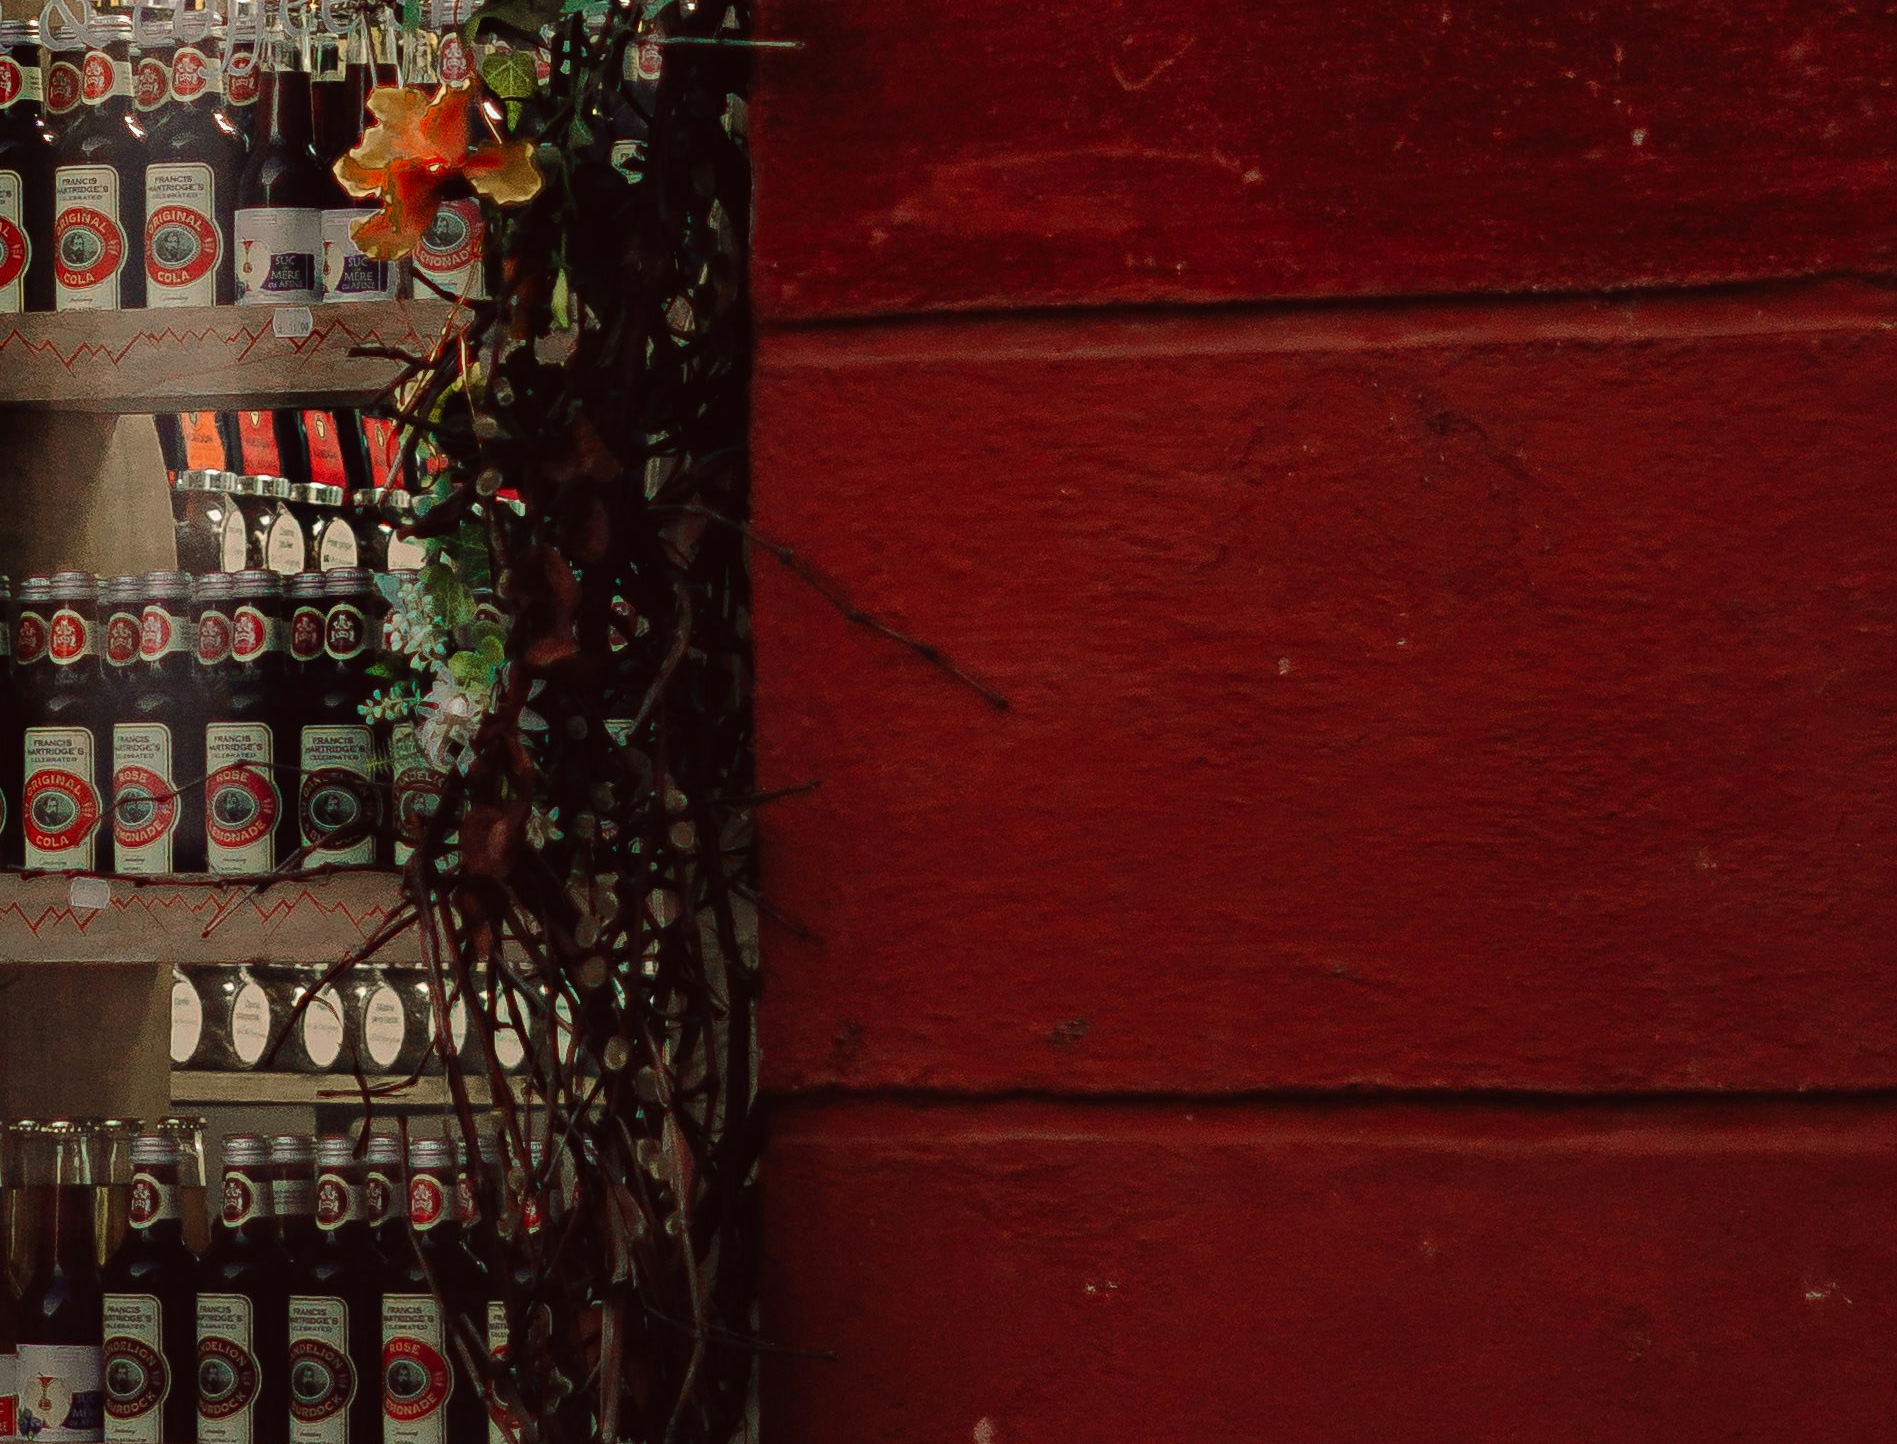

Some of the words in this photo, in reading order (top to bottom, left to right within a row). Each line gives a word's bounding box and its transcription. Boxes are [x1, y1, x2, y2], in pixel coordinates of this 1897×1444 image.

[63, 272, 95, 284] COLA
[157, 270, 191, 284] COLA
[118, 770, 148, 783] ROSE
[216, 770, 250, 783] ROSE
[27, 774, 82, 796] ORIGINAL
[36, 835, 70, 847] COLA
[389, 1342, 421, 1355] ROSE
[384, 1393, 439, 1415] EMONADE
